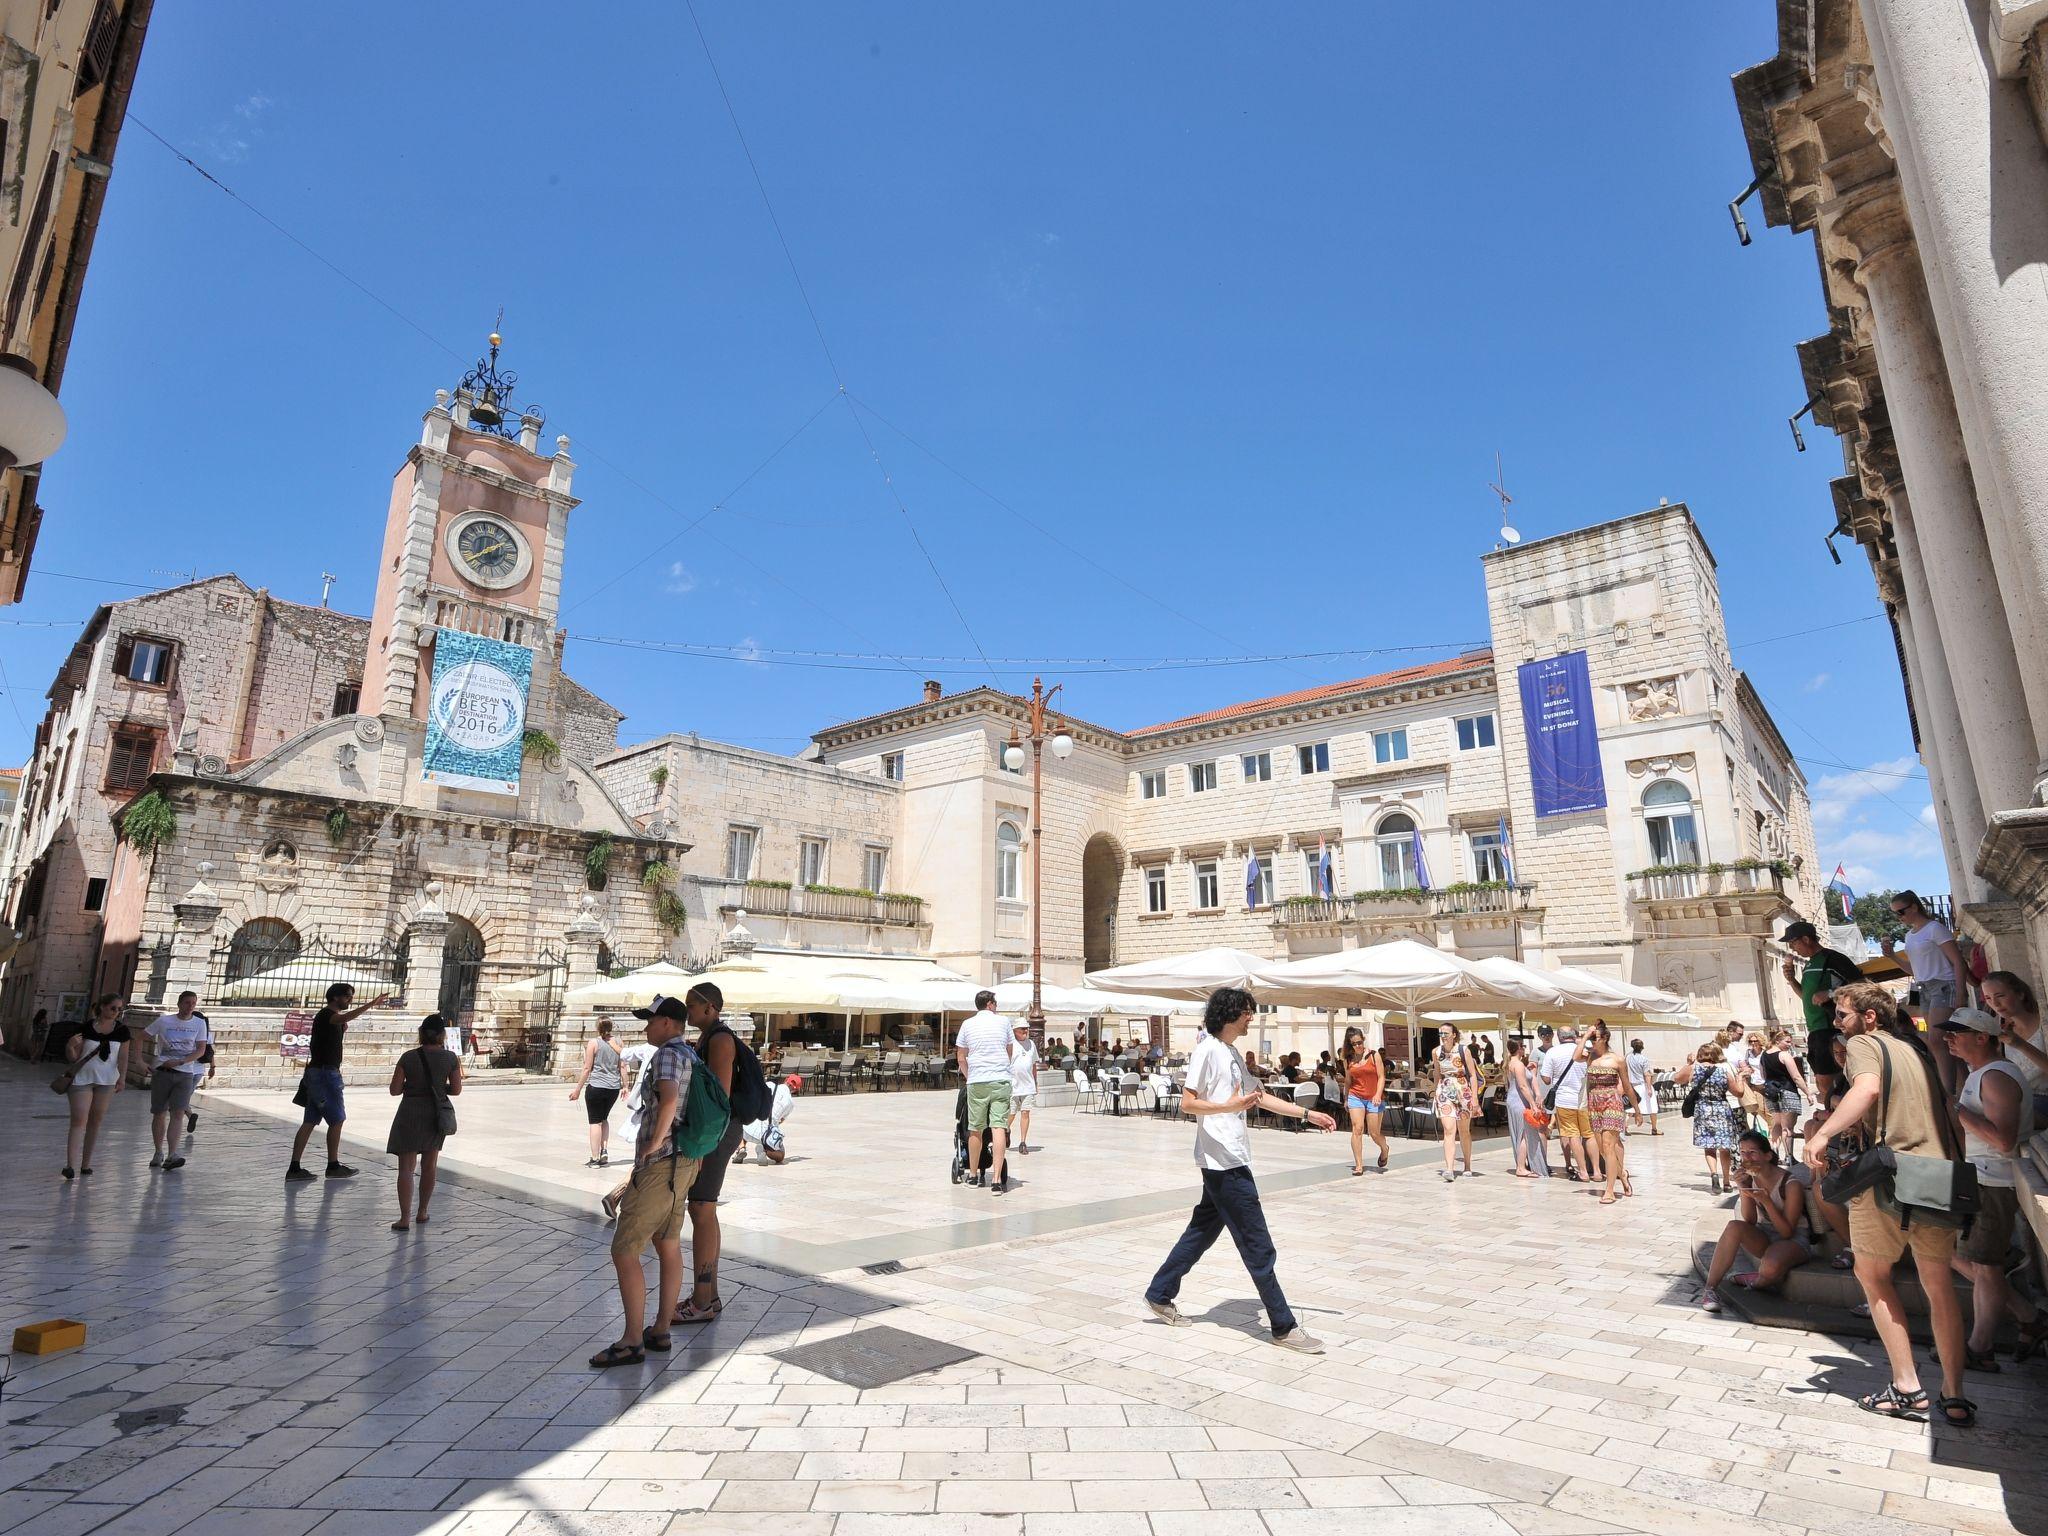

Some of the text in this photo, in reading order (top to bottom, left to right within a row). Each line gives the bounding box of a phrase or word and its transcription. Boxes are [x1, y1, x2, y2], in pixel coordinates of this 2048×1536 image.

[480, 675, 513, 688] ELECTED
[1546, 682, 1566, 697] 56
[460, 691, 500, 704] EUROPEAN
[1543, 697, 1571, 708] MUSICAL
[459, 697, 498, 715] BEST
[458, 709, 498, 721] DESTINATION
[457, 715, 497, 734] 2016
[1557, 719, 1580, 729] DONAT
[462, 731, 490, 743] ZADAR
